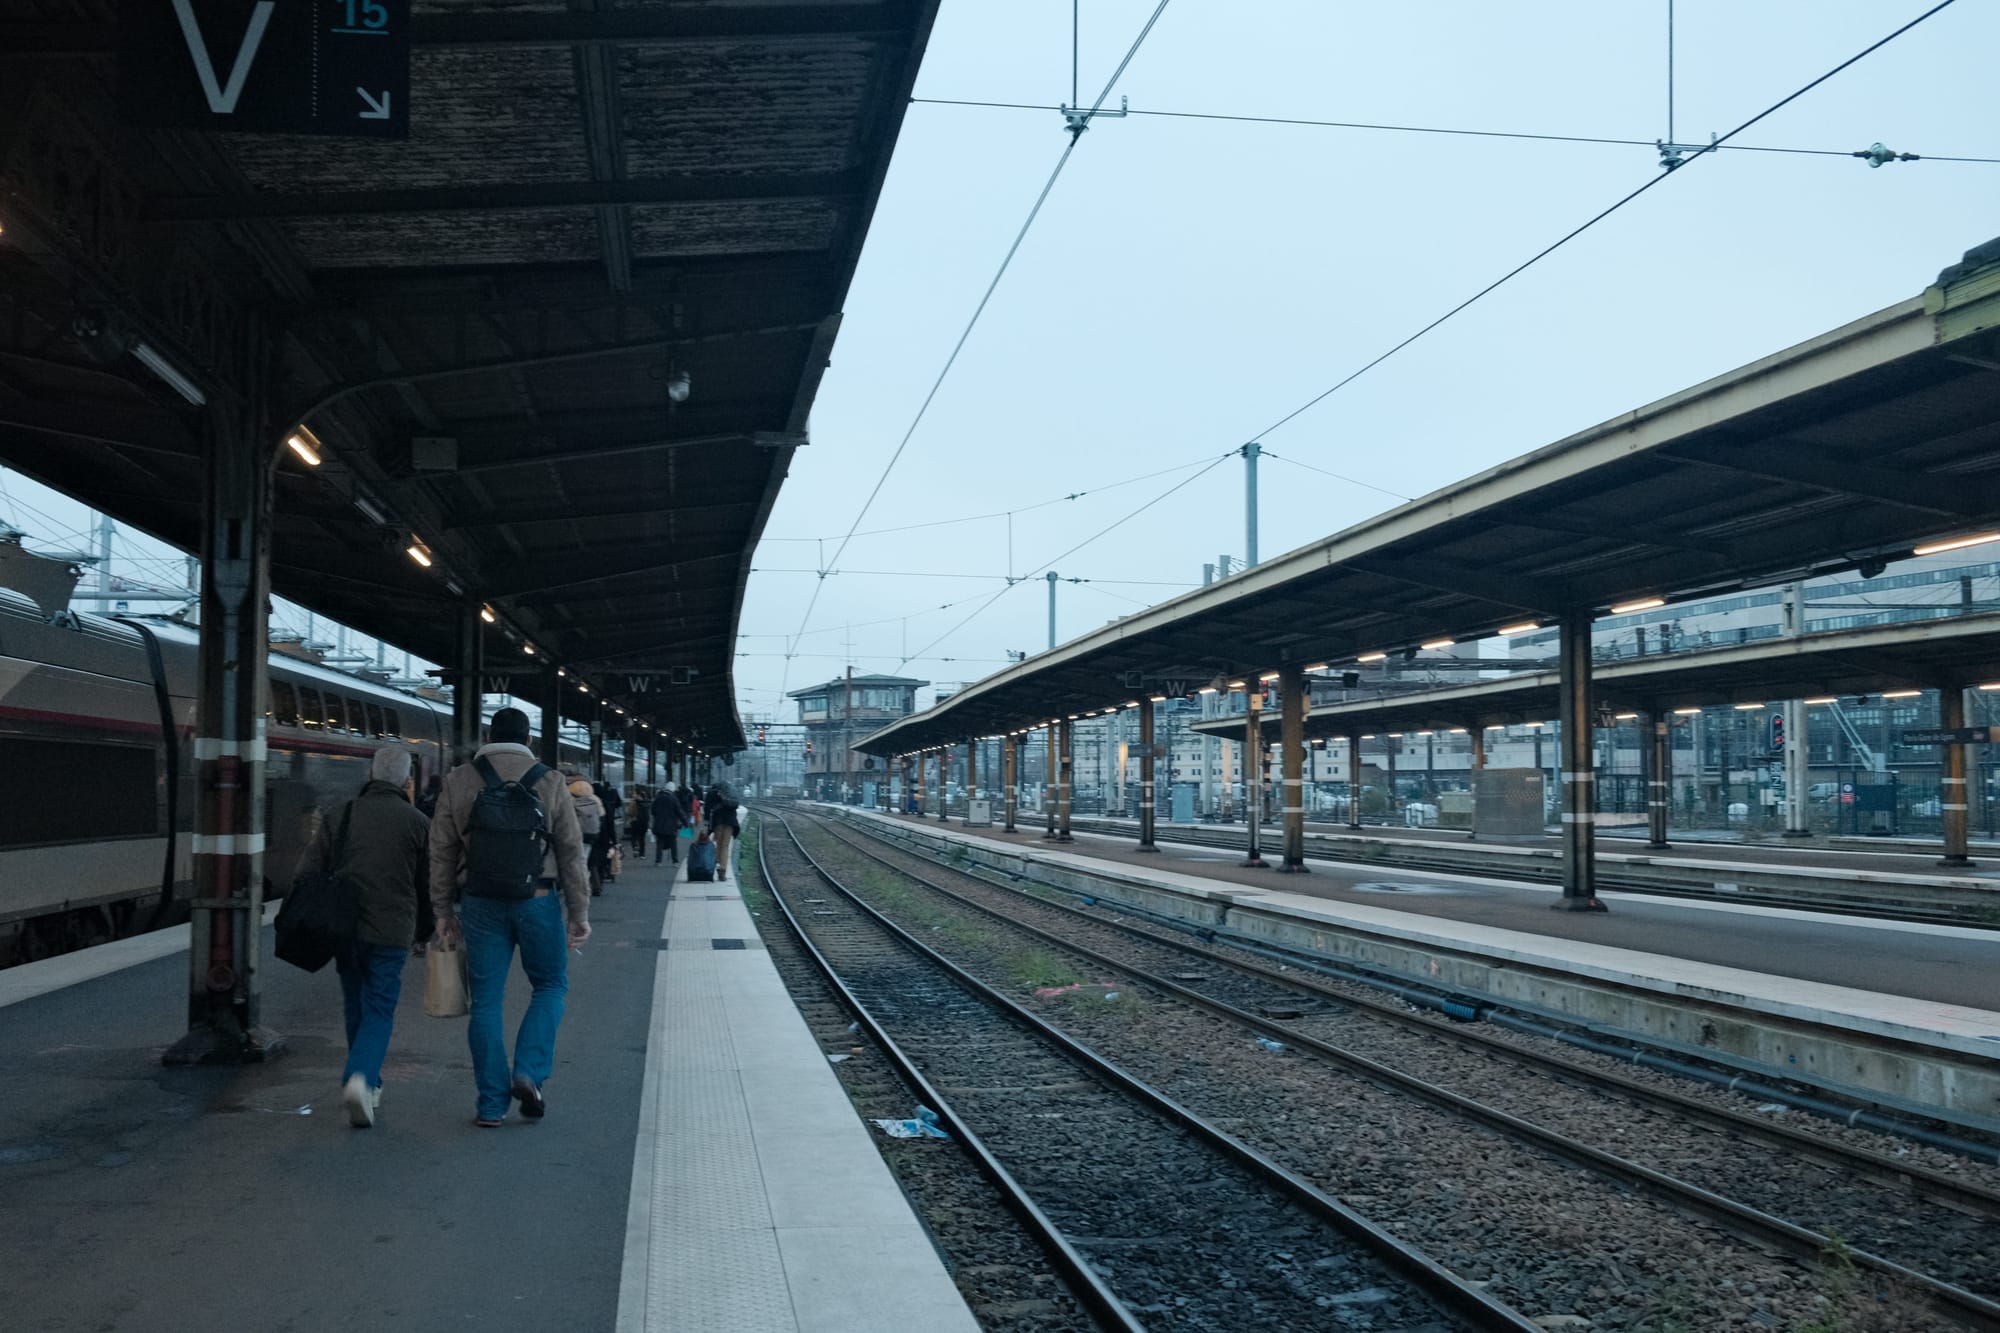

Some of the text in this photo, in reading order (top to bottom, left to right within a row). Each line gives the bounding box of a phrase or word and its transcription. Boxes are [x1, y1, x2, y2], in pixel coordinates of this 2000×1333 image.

[337, 0, 389, 28] 15
[171, 0, 276, 113] V
[489, 676, 511, 692] W
[629, 676, 649, 692] W
[1166, 680, 1186, 696] W
[1600, 714, 1616, 727] W
